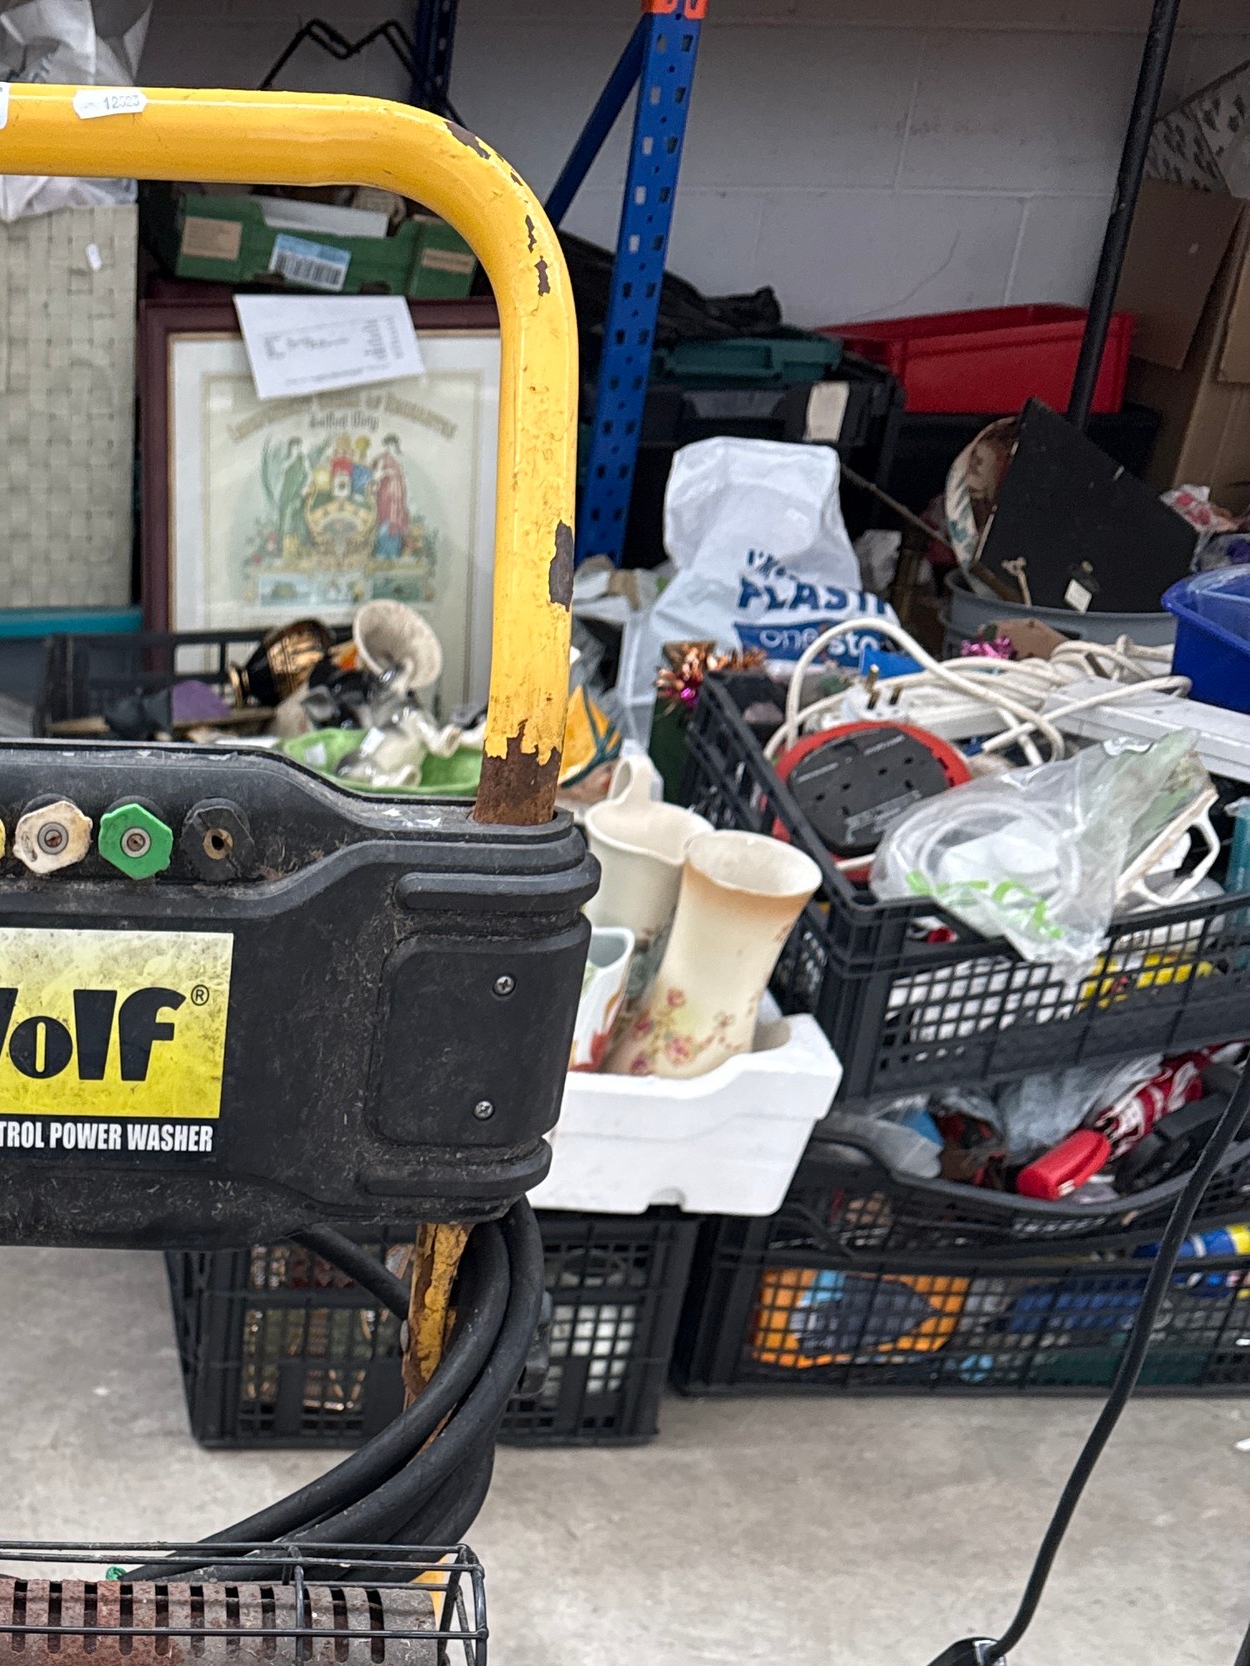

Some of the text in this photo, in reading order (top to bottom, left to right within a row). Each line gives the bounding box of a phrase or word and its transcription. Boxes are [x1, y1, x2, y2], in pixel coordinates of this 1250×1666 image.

[103, 95, 140, 110] 12523
[759, 627, 819, 650] one
[49, 1122, 122, 1150] POWER
[127, 1124, 214, 1152] WASHER
